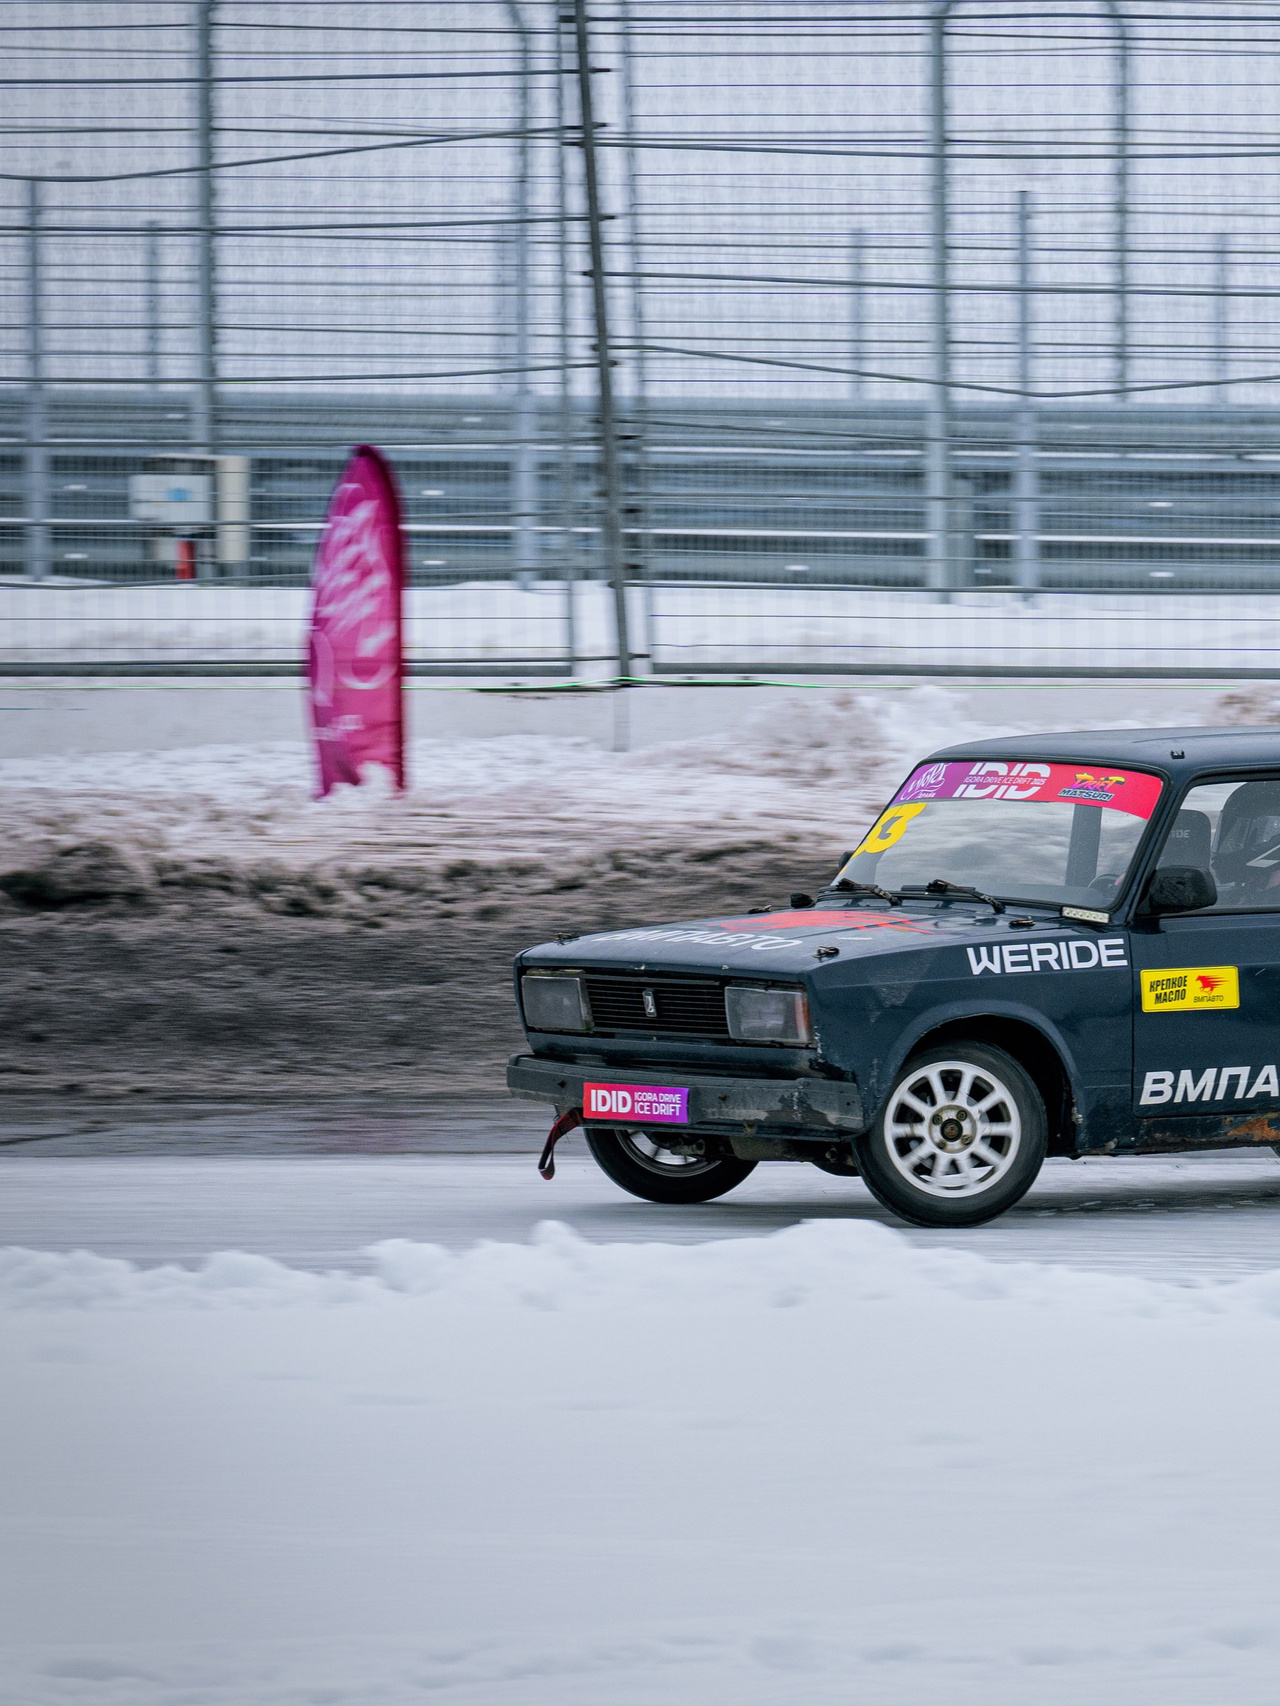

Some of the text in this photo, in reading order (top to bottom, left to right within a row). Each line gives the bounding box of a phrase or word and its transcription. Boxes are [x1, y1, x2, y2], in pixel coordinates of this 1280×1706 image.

[1057, 788, 1115, 802] MATSURI
[966, 938, 1129, 976] WERIDE
[1149, 975, 1188, 992] КРЕПКОЕ
[1154, 988, 1187, 1005] МАСЛО
[1193, 995, 1224, 1003] ВМПАВТО
[590, 1089, 632, 1113] IDID
[634, 1091, 682, 1104] IGORA DRIVE
[634, 1102, 682, 1116] ICE DRIFT
